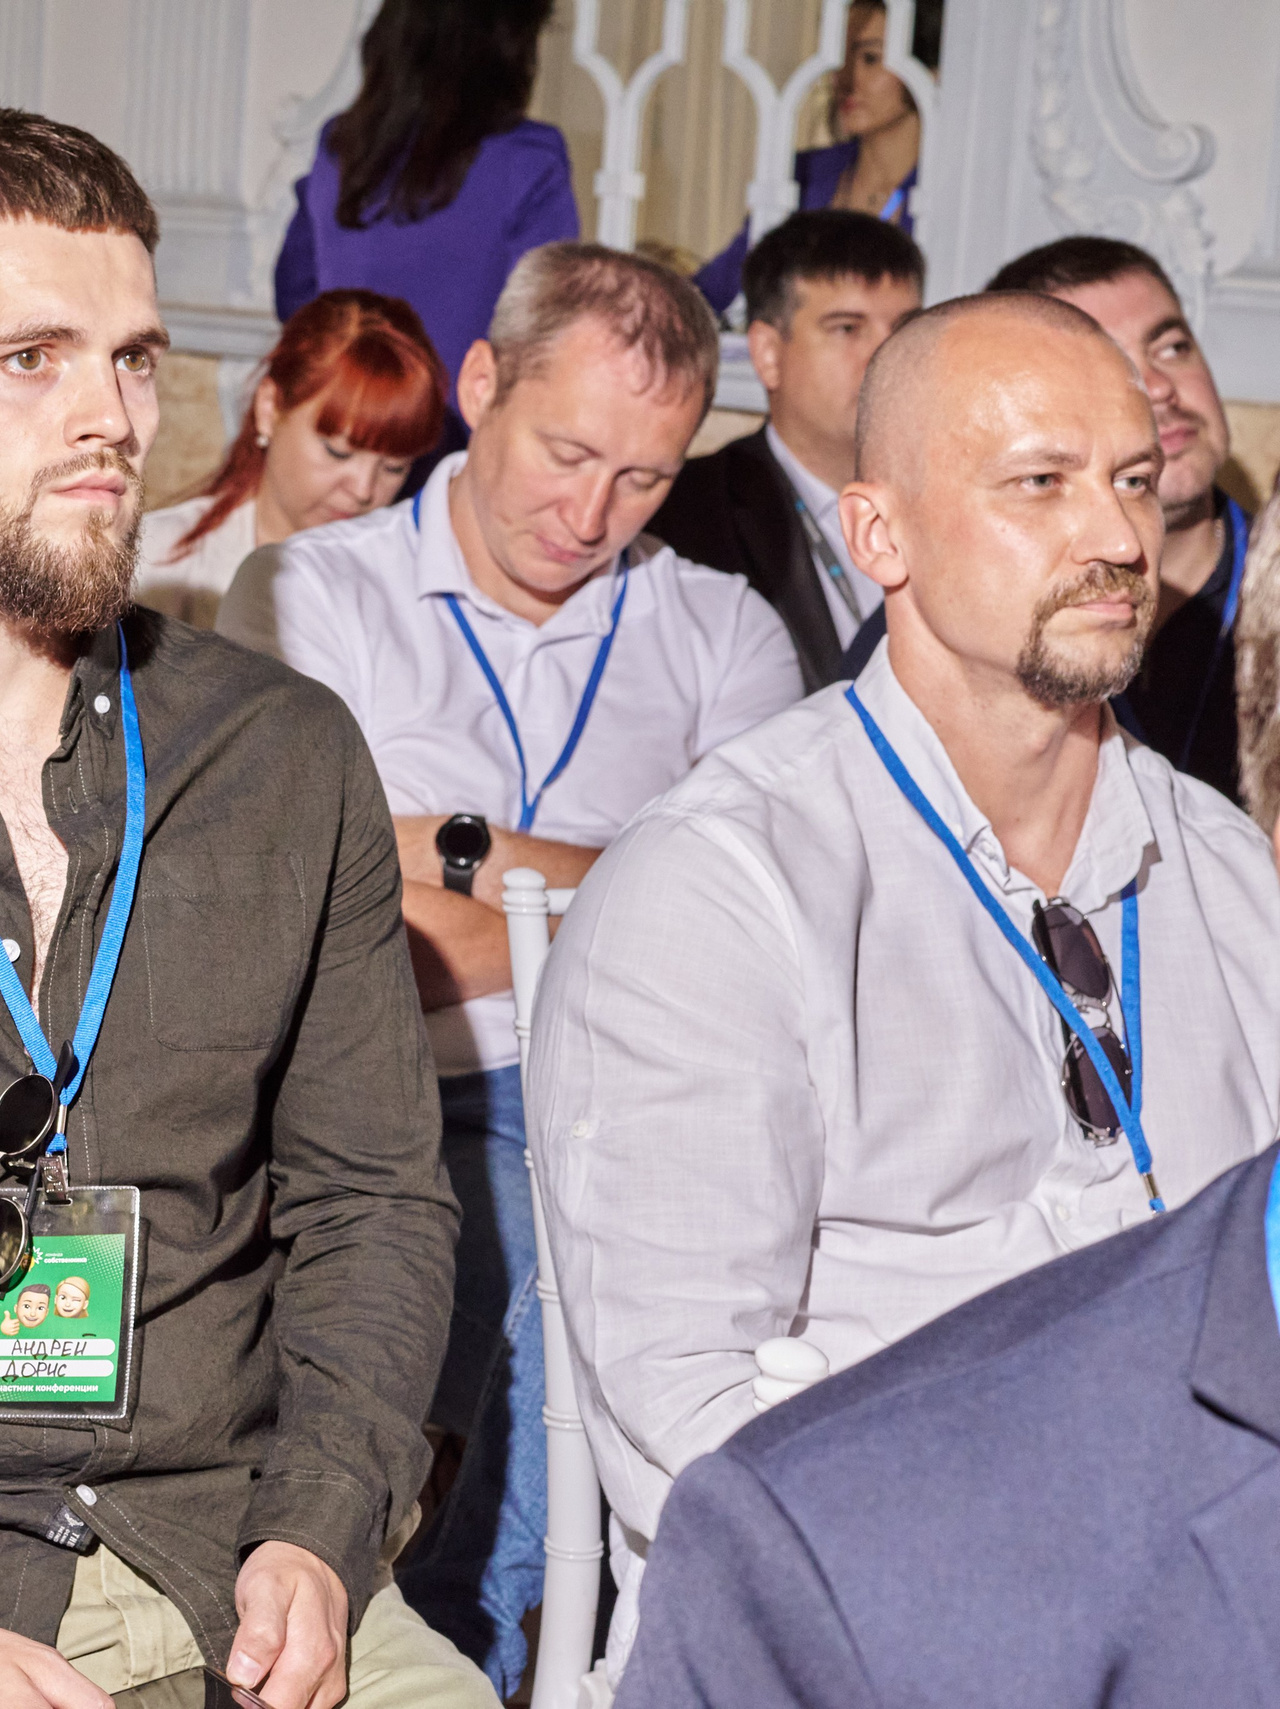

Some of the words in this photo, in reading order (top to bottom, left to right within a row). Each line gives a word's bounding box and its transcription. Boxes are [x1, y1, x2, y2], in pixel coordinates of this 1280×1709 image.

[11, 1333, 97, 1360] АНДРЕЙ
[1, 1359, 68, 1382] ДОРИС
[35, 1383, 99, 1394] конференции
